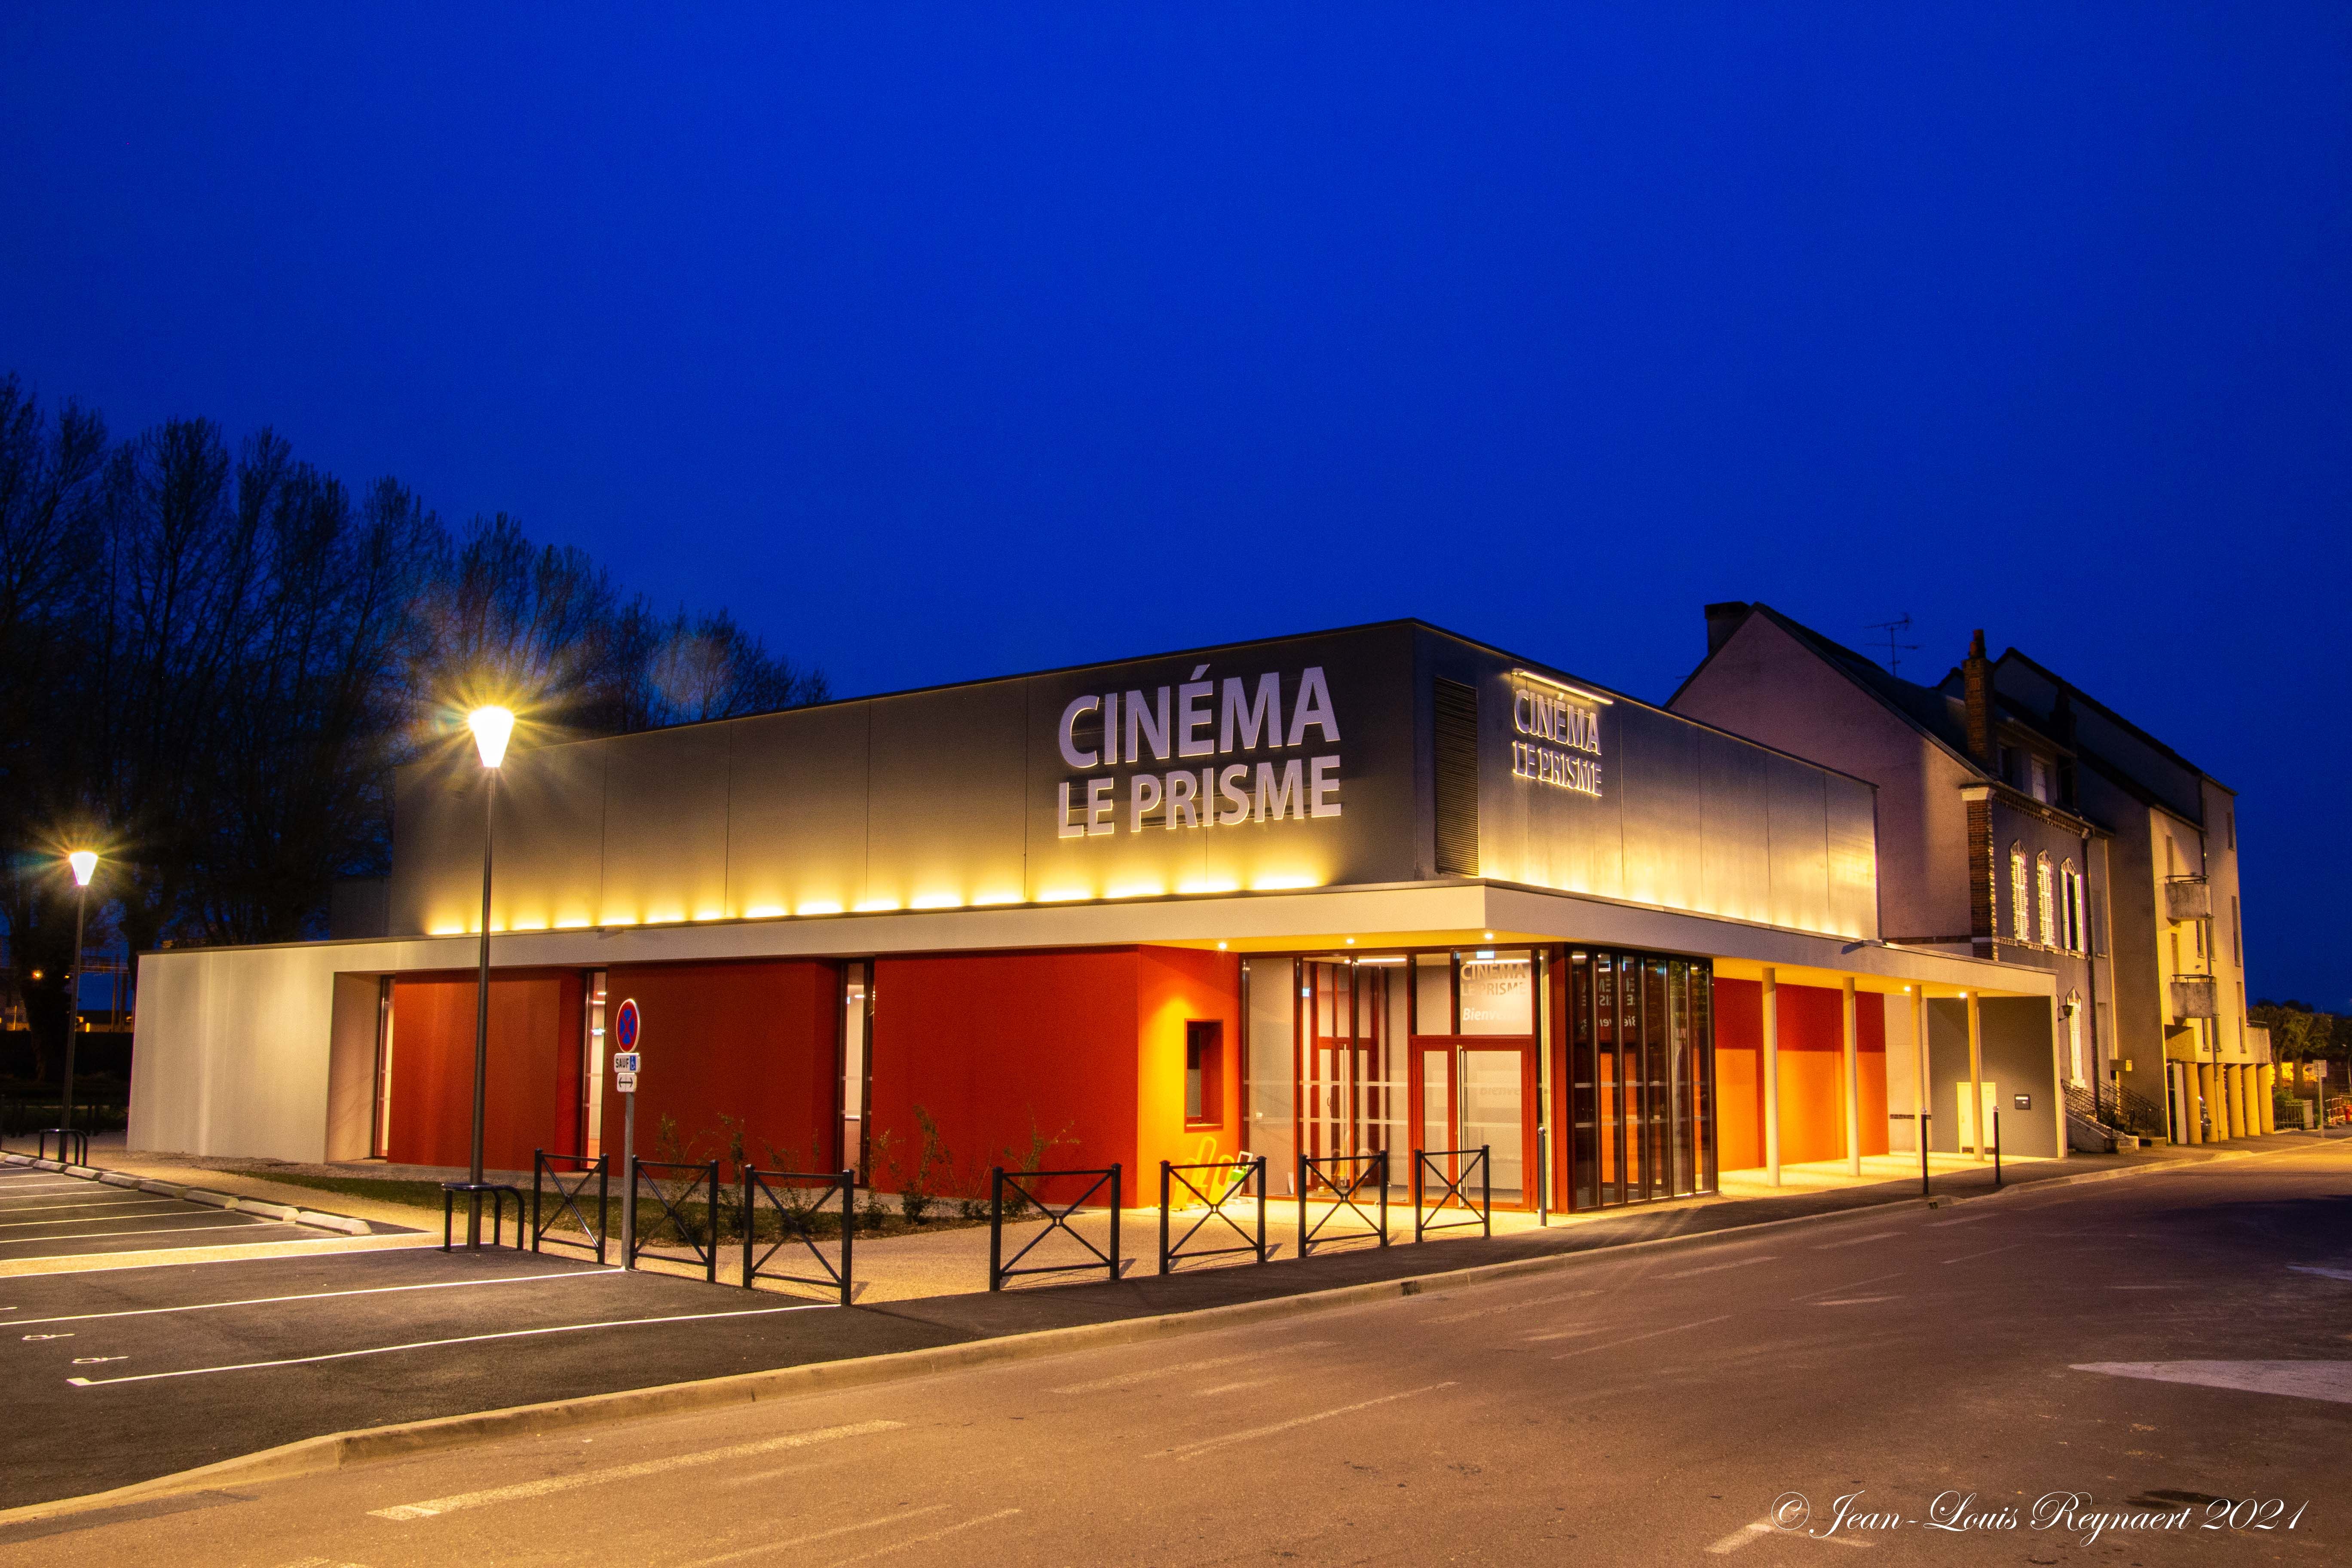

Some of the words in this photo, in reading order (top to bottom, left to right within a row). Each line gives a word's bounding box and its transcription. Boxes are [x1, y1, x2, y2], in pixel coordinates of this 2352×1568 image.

[1059, 664, 1341, 768] CINÉMA
[1514, 689, 1602, 755] CINÉMA
[1058, 778, 1115, 839] LE
[1130, 755, 1341, 833] PRISME
[1513, 740, 1536, 779] LE
[1538, 747, 1602, 796] PRISME
[616, 1058, 629, 1068] SAUF
